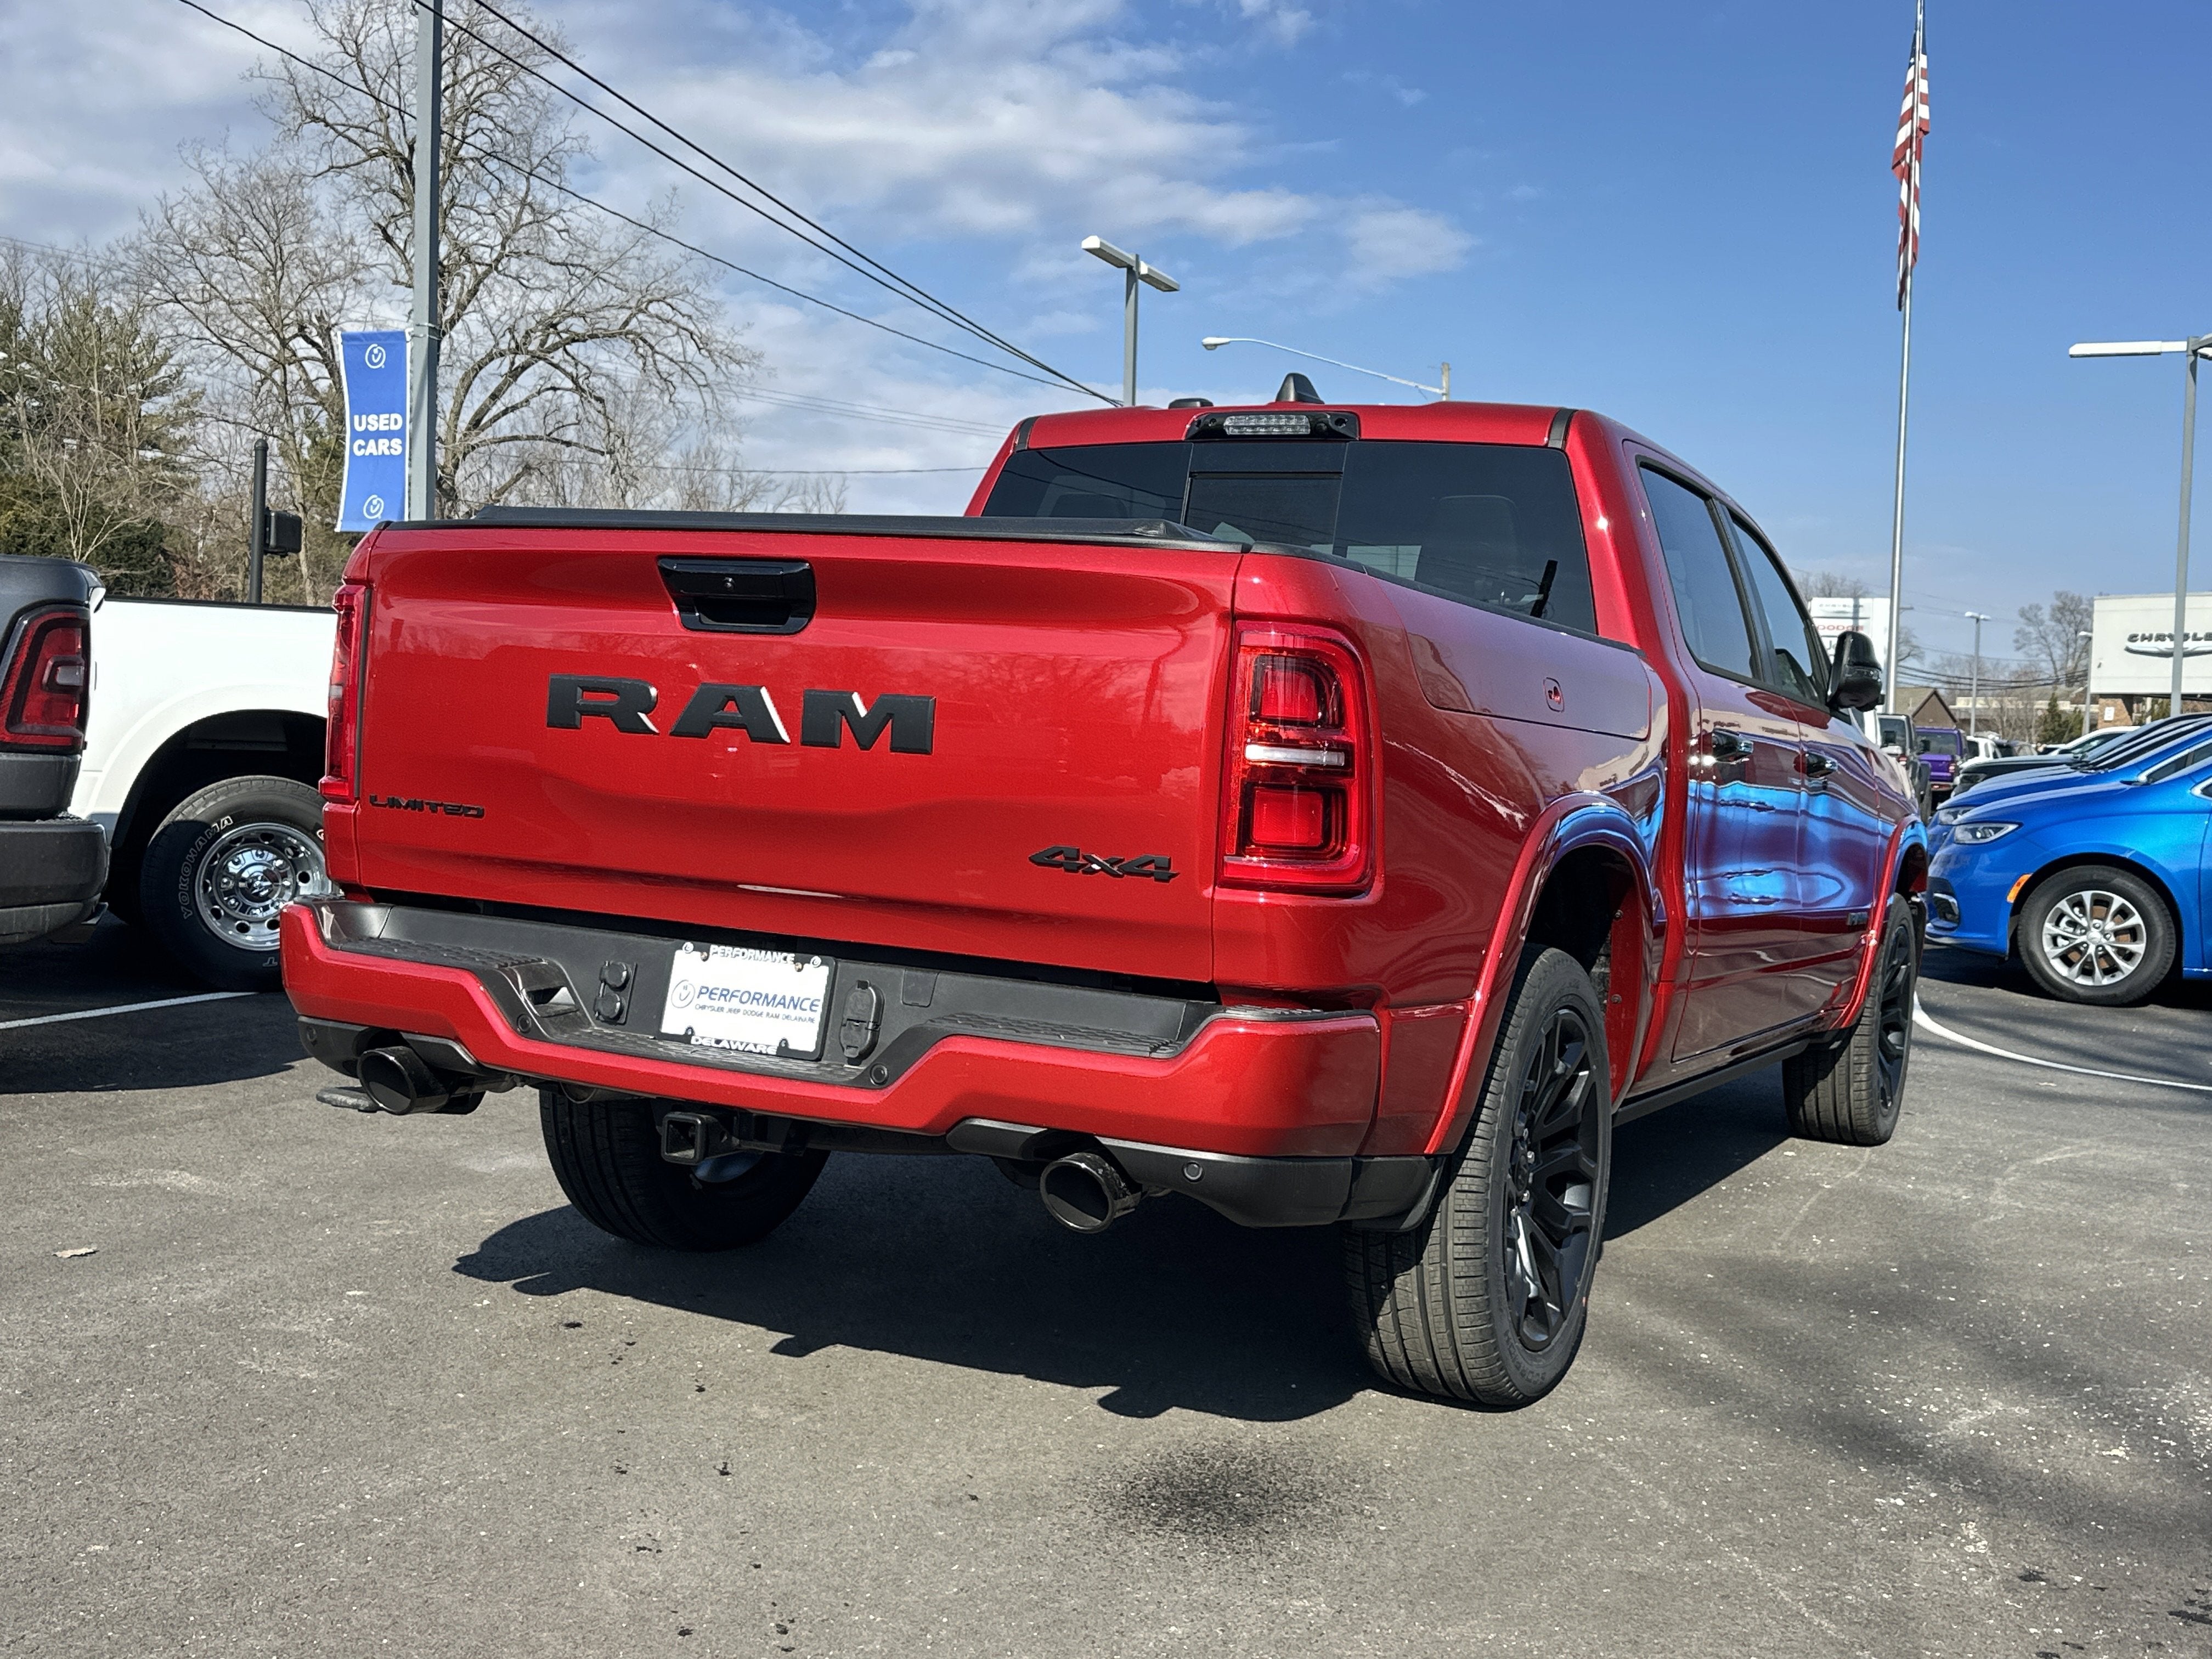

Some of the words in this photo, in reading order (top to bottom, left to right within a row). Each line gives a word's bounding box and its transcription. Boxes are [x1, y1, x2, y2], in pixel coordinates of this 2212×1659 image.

[354, 413, 403, 431] USED
[353, 438, 403, 456] CARS
[546, 674, 937, 755] RAM
[369, 794, 485, 819] LIMITED
[178, 815, 234, 919] YOKOHAMA
[1028, 845, 1179, 882] 4x4
[709, 945, 795, 964] PERFORMANCE
[696, 985, 821, 1013] PERFORMANCE
[695, 1004, 724, 1013] CHRYSLER
[742, 1009, 764, 1018] DODGE
[782, 1014, 816, 1024] DELAWARE
[691, 1035, 778, 1055] DELAWARE
